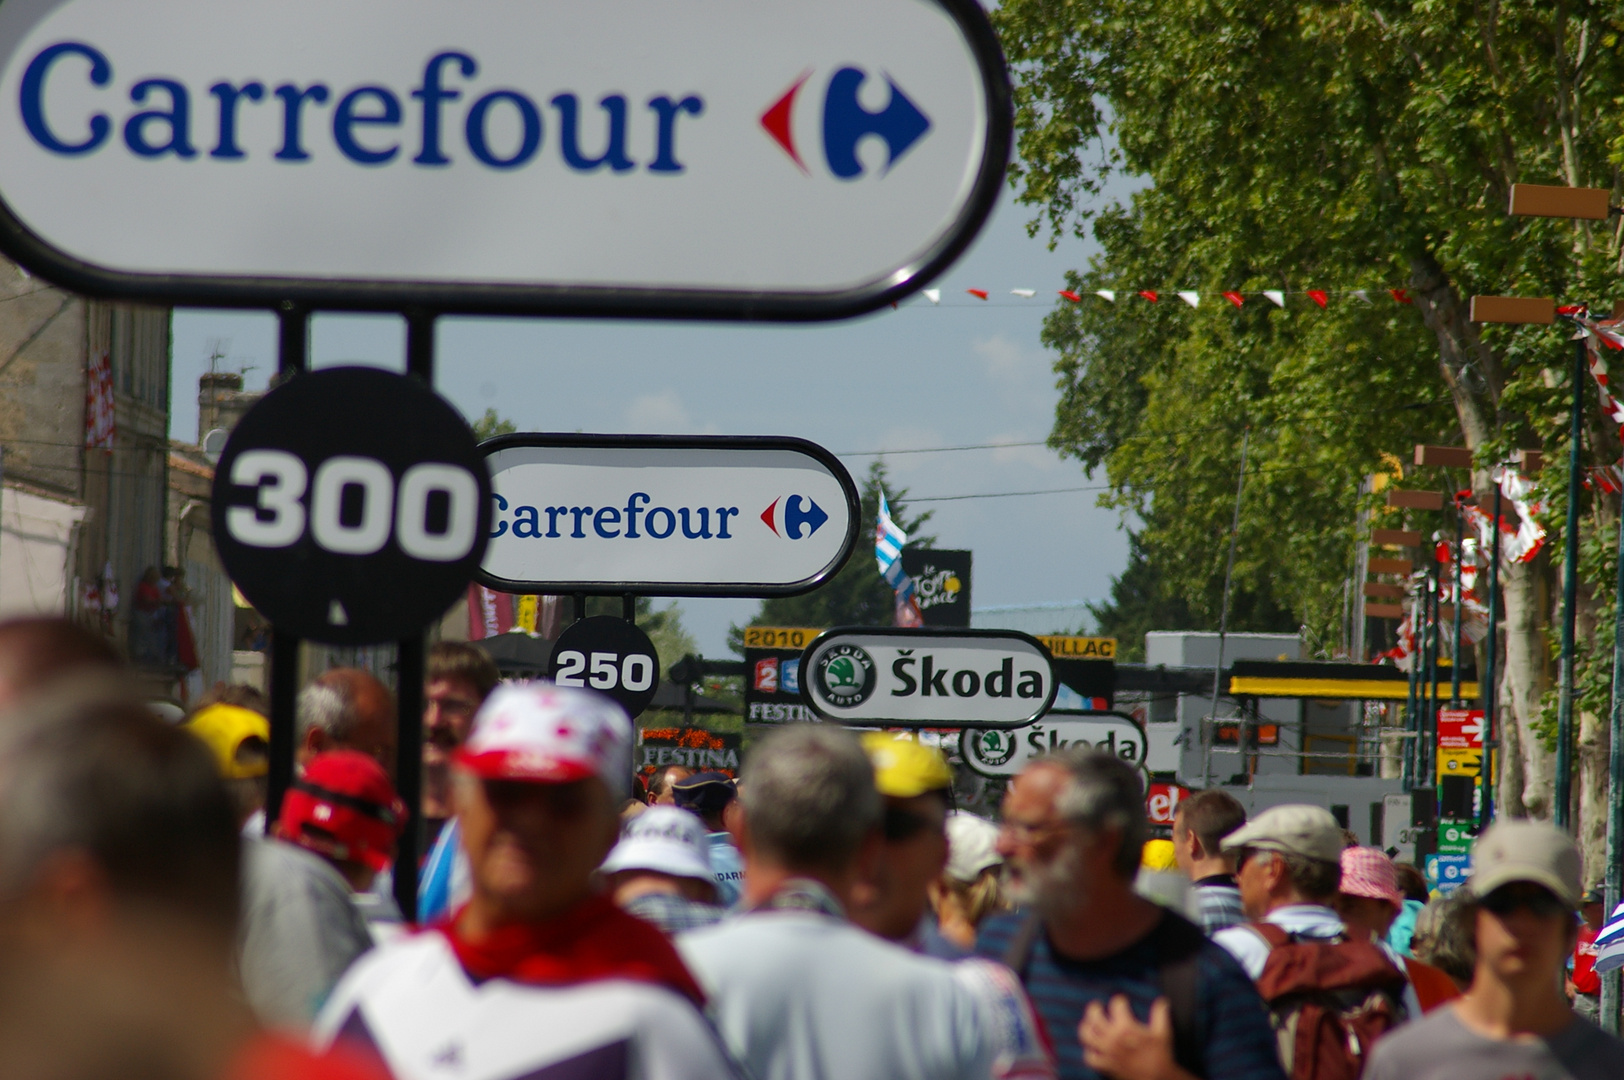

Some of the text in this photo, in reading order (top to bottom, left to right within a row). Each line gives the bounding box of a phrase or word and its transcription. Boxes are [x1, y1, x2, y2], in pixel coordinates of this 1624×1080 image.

[18, 41, 706, 174] Carrefour
[225, 448, 480, 562] 300
[748, 630, 804, 647] 2010
[555, 650, 654, 692] 250
[760, 667, 777, 689] 2
[891, 649, 1043, 698] Škoda
[643, 747, 739, 767] FESTINA
